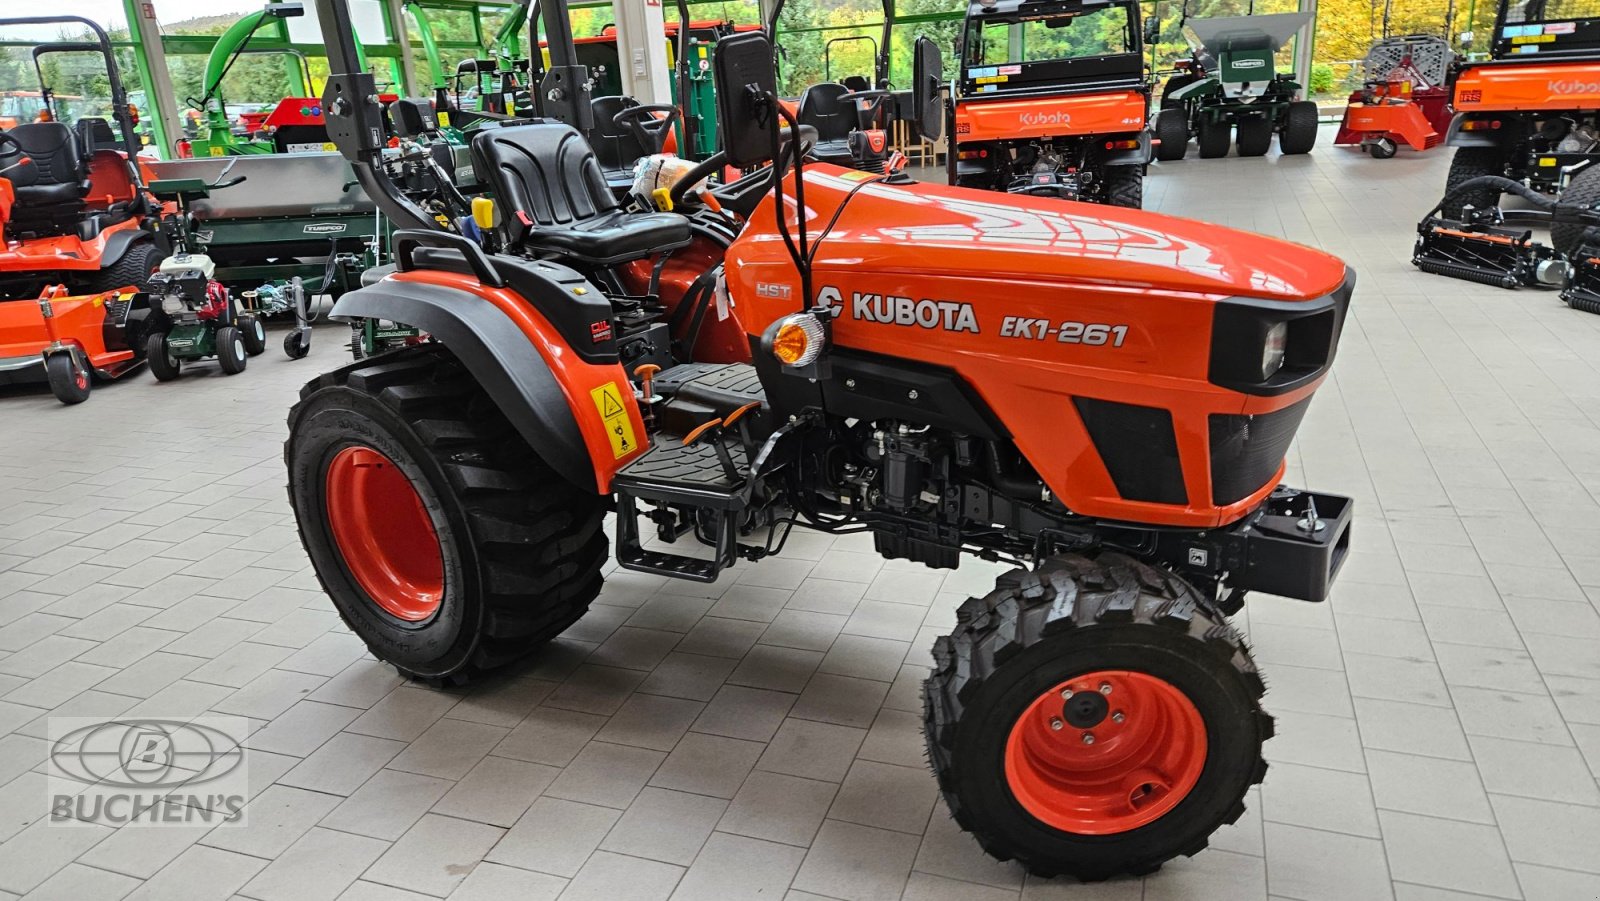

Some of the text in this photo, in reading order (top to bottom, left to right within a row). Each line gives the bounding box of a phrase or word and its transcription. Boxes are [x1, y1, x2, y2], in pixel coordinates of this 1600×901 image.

[1547, 79, 1600, 94] Kubo
[1019, 111, 1071, 125] Kubota
[756, 283, 791, 298] HST
[852, 292, 980, 334] KUBOTA
[999, 315, 1129, 348] EK1-261
